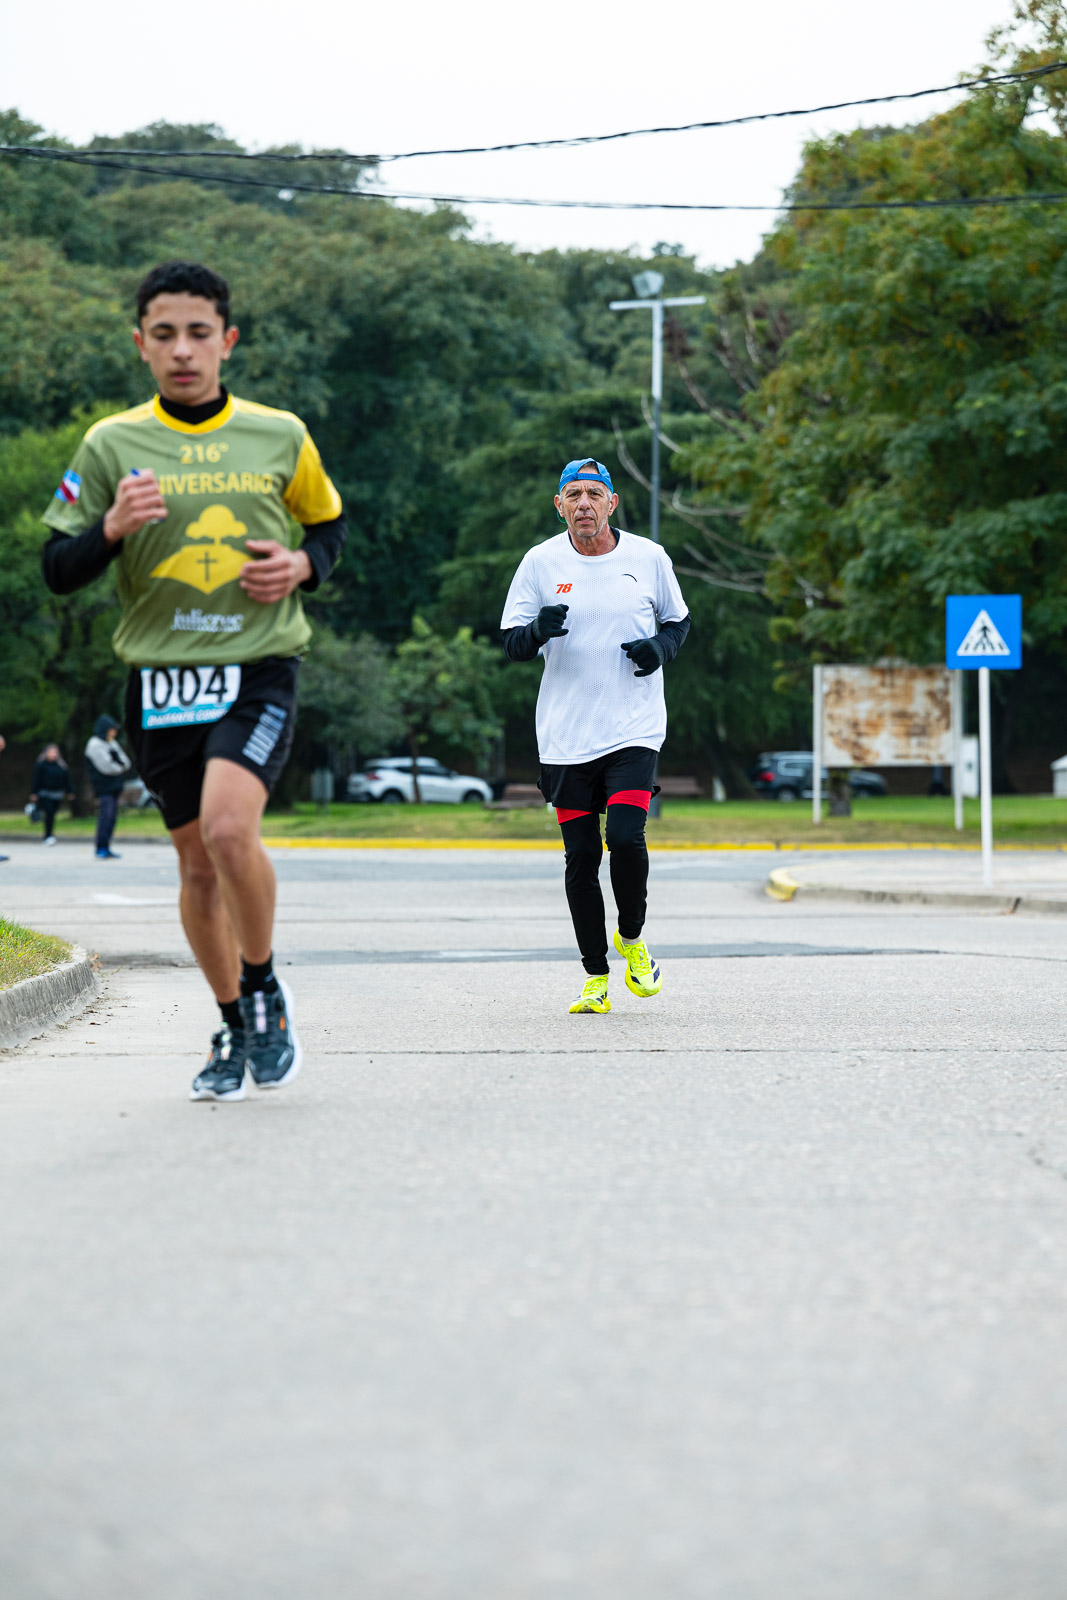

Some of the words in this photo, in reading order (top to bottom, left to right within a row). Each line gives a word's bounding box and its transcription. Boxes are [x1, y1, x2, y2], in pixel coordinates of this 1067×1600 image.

[180, 442, 229, 464] 216°
[556, 583, 573, 594] 78
[151, 666, 228, 709] 004
